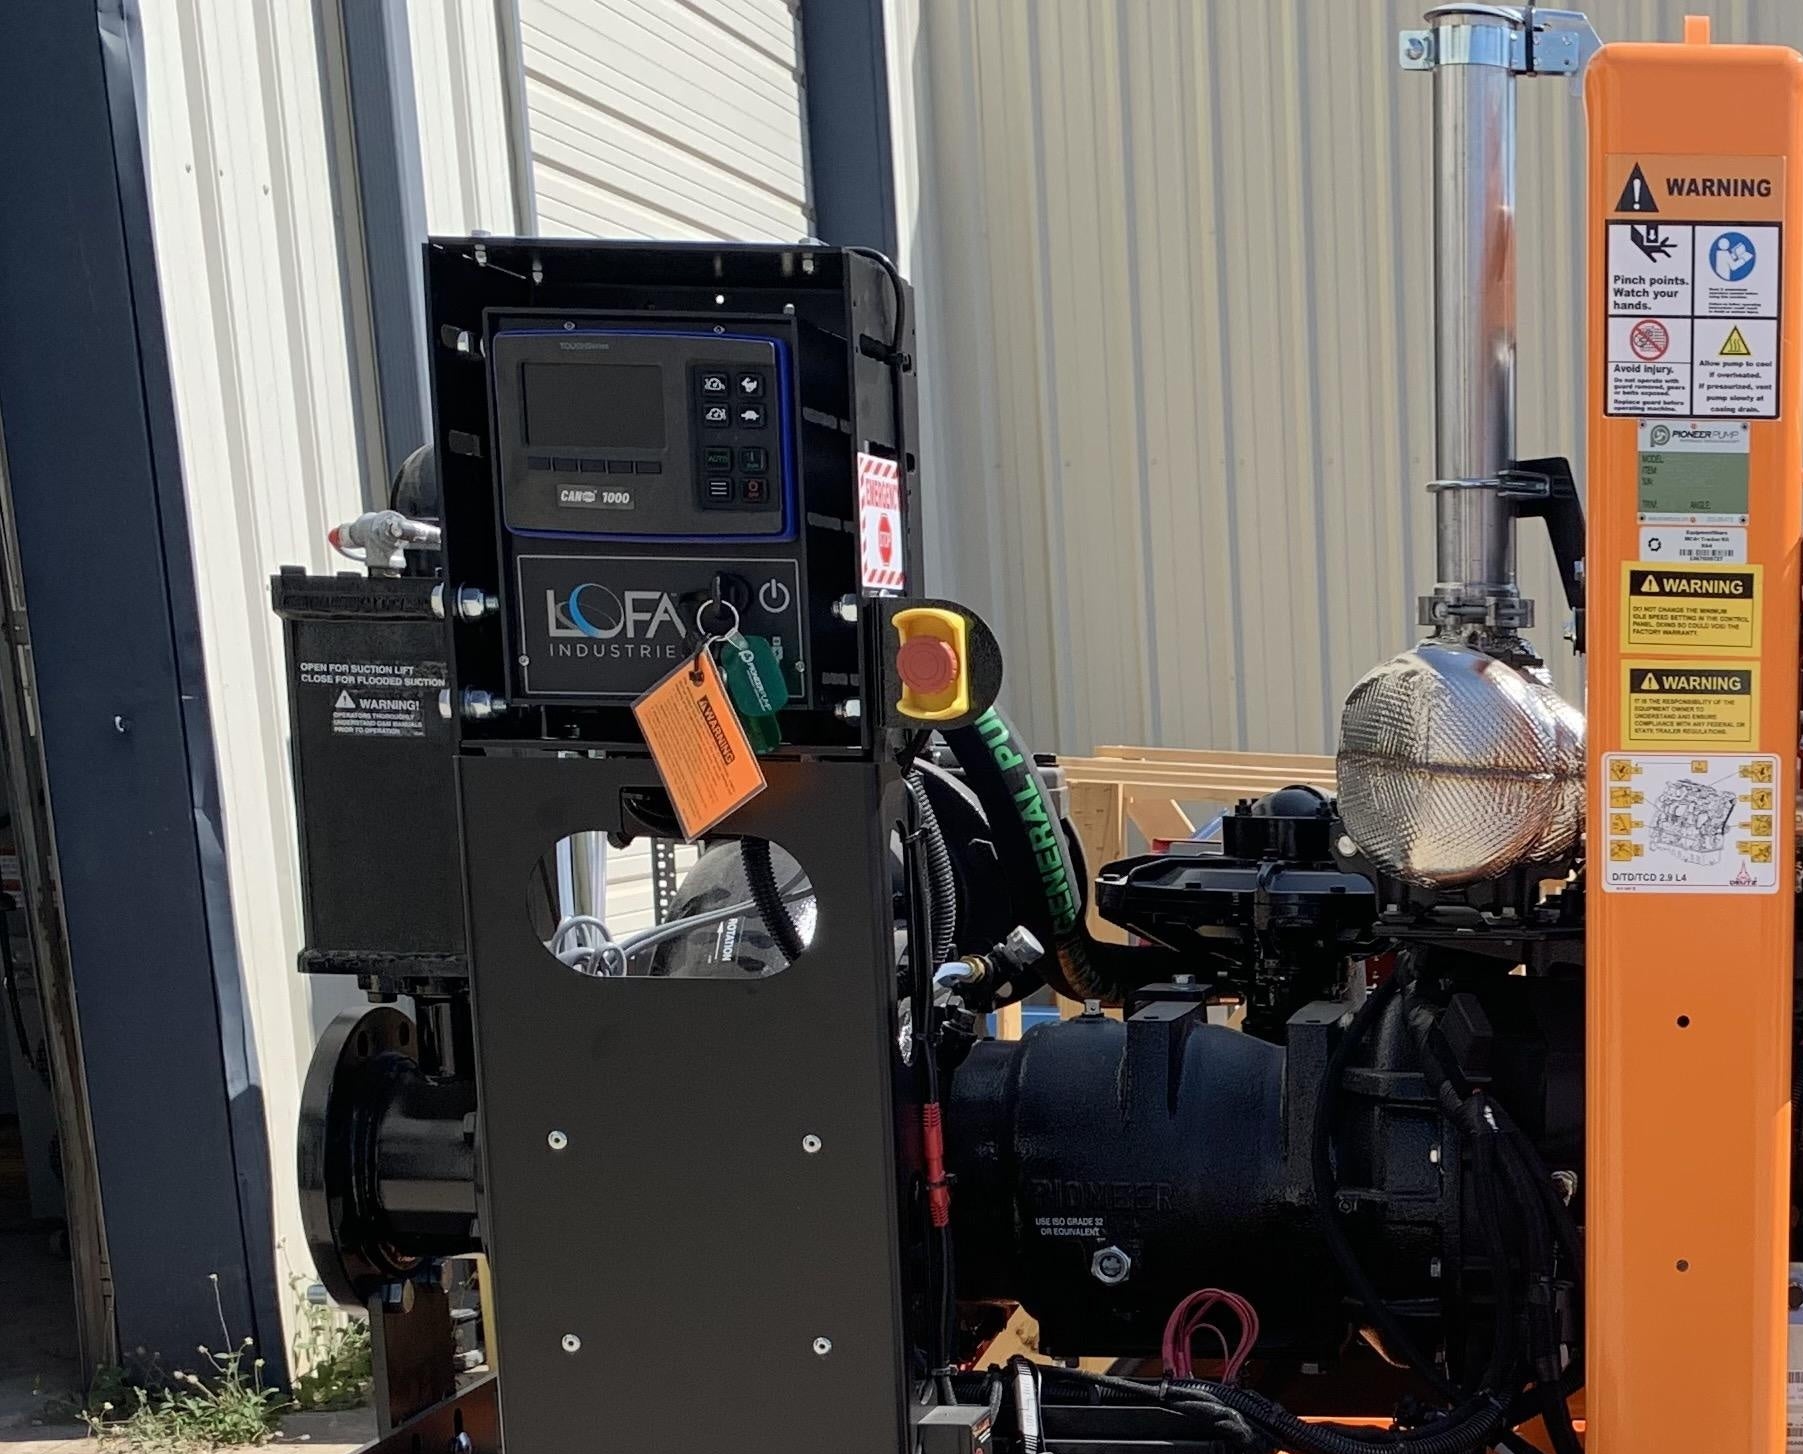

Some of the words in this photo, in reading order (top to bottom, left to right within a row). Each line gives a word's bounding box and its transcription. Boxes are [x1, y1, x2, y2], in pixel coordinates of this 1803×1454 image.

[1666, 178, 1772, 197] WARNING
[1613, 274, 1646, 285] Pinch
[1649, 275, 1689, 287] points.
[1613, 288, 1649, 298] Watch
[1653, 290, 1679, 300] your
[1613, 300, 1652, 310] hands.
[1614, 364, 1641, 373] Avoid
[1644, 365, 1674, 376] injury.
[602, 492, 630, 504] 1000
[1663, 578, 1744, 594] WARNING
[546, 583, 687, 639] LOFA
[550, 644, 684, 659] INDUSTRIE
[301, 663, 327, 672] OPEN
[329, 664, 349, 673] FOR
[351, 665, 392, 674] SUCTION
[395, 666, 414, 675] LIFT
[301, 674, 333, 683] CLOSE
[335, 675, 355, 684] FOR
[357, 676, 402, 686] FLOODED
[404, 678, 445, 687] SUCTION
[1662, 676, 1741, 690] WARNING
[360, 699, 420, 710] WARNING!
[703, 705, 735, 765] WARNING
[1013, 773, 1077, 935] GENERAL
[1612, 872, 1657, 882] D/TD/TCD
[1659, 873, 1673, 882] 2.9
[1676, 874, 1687, 882] L4
[722, 918, 738, 961] ROTATION
[1036, 1218, 1051, 1226] USE
[1052, 1218, 1065, 1226] ISO
[1067, 1218, 1093, 1226] GRADE
[1054, 1227, 1100, 1236] EQUIVALENT
